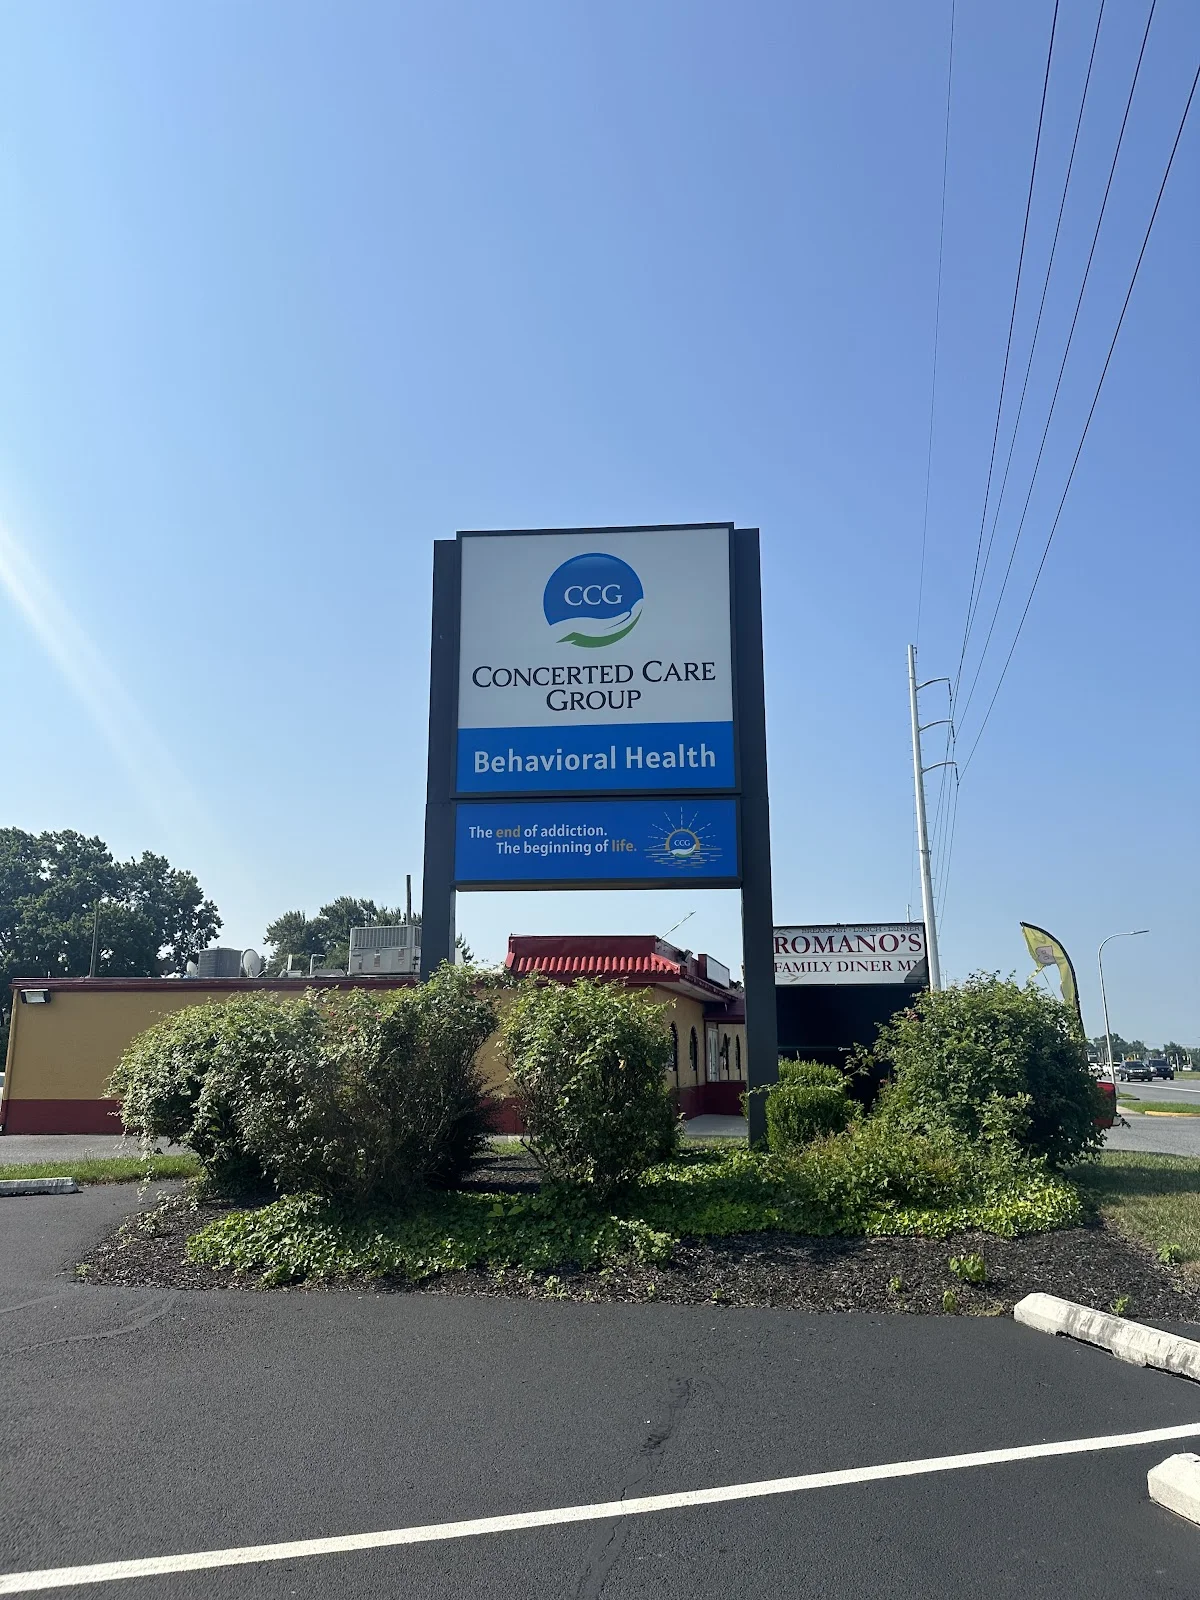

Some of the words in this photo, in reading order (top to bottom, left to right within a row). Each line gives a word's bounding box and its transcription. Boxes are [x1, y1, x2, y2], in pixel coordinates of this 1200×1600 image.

[564, 585, 622, 606] CCG
[472, 664, 634, 688] CONCERTED
[642, 660, 717, 683] CARE
[546, 689, 642, 711] GROUP
[474, 745, 616, 773] Behavioral
[626, 743, 717, 769] Health
[469, 826, 493, 839] The
[496, 825, 521, 838] end
[523, 824, 539, 838] of
[540, 824, 608, 837] addiction.
[496, 842, 521, 855] The
[523, 841, 592, 856] beginning
[595, 840, 609, 853] of
[611, 839, 637, 852] life.
[673, 839, 691, 847] CCG
[774, 934, 922, 954] ROMANO'S
[774, 961, 833, 973] FAMILY
[837, 960, 893, 972] DINER
